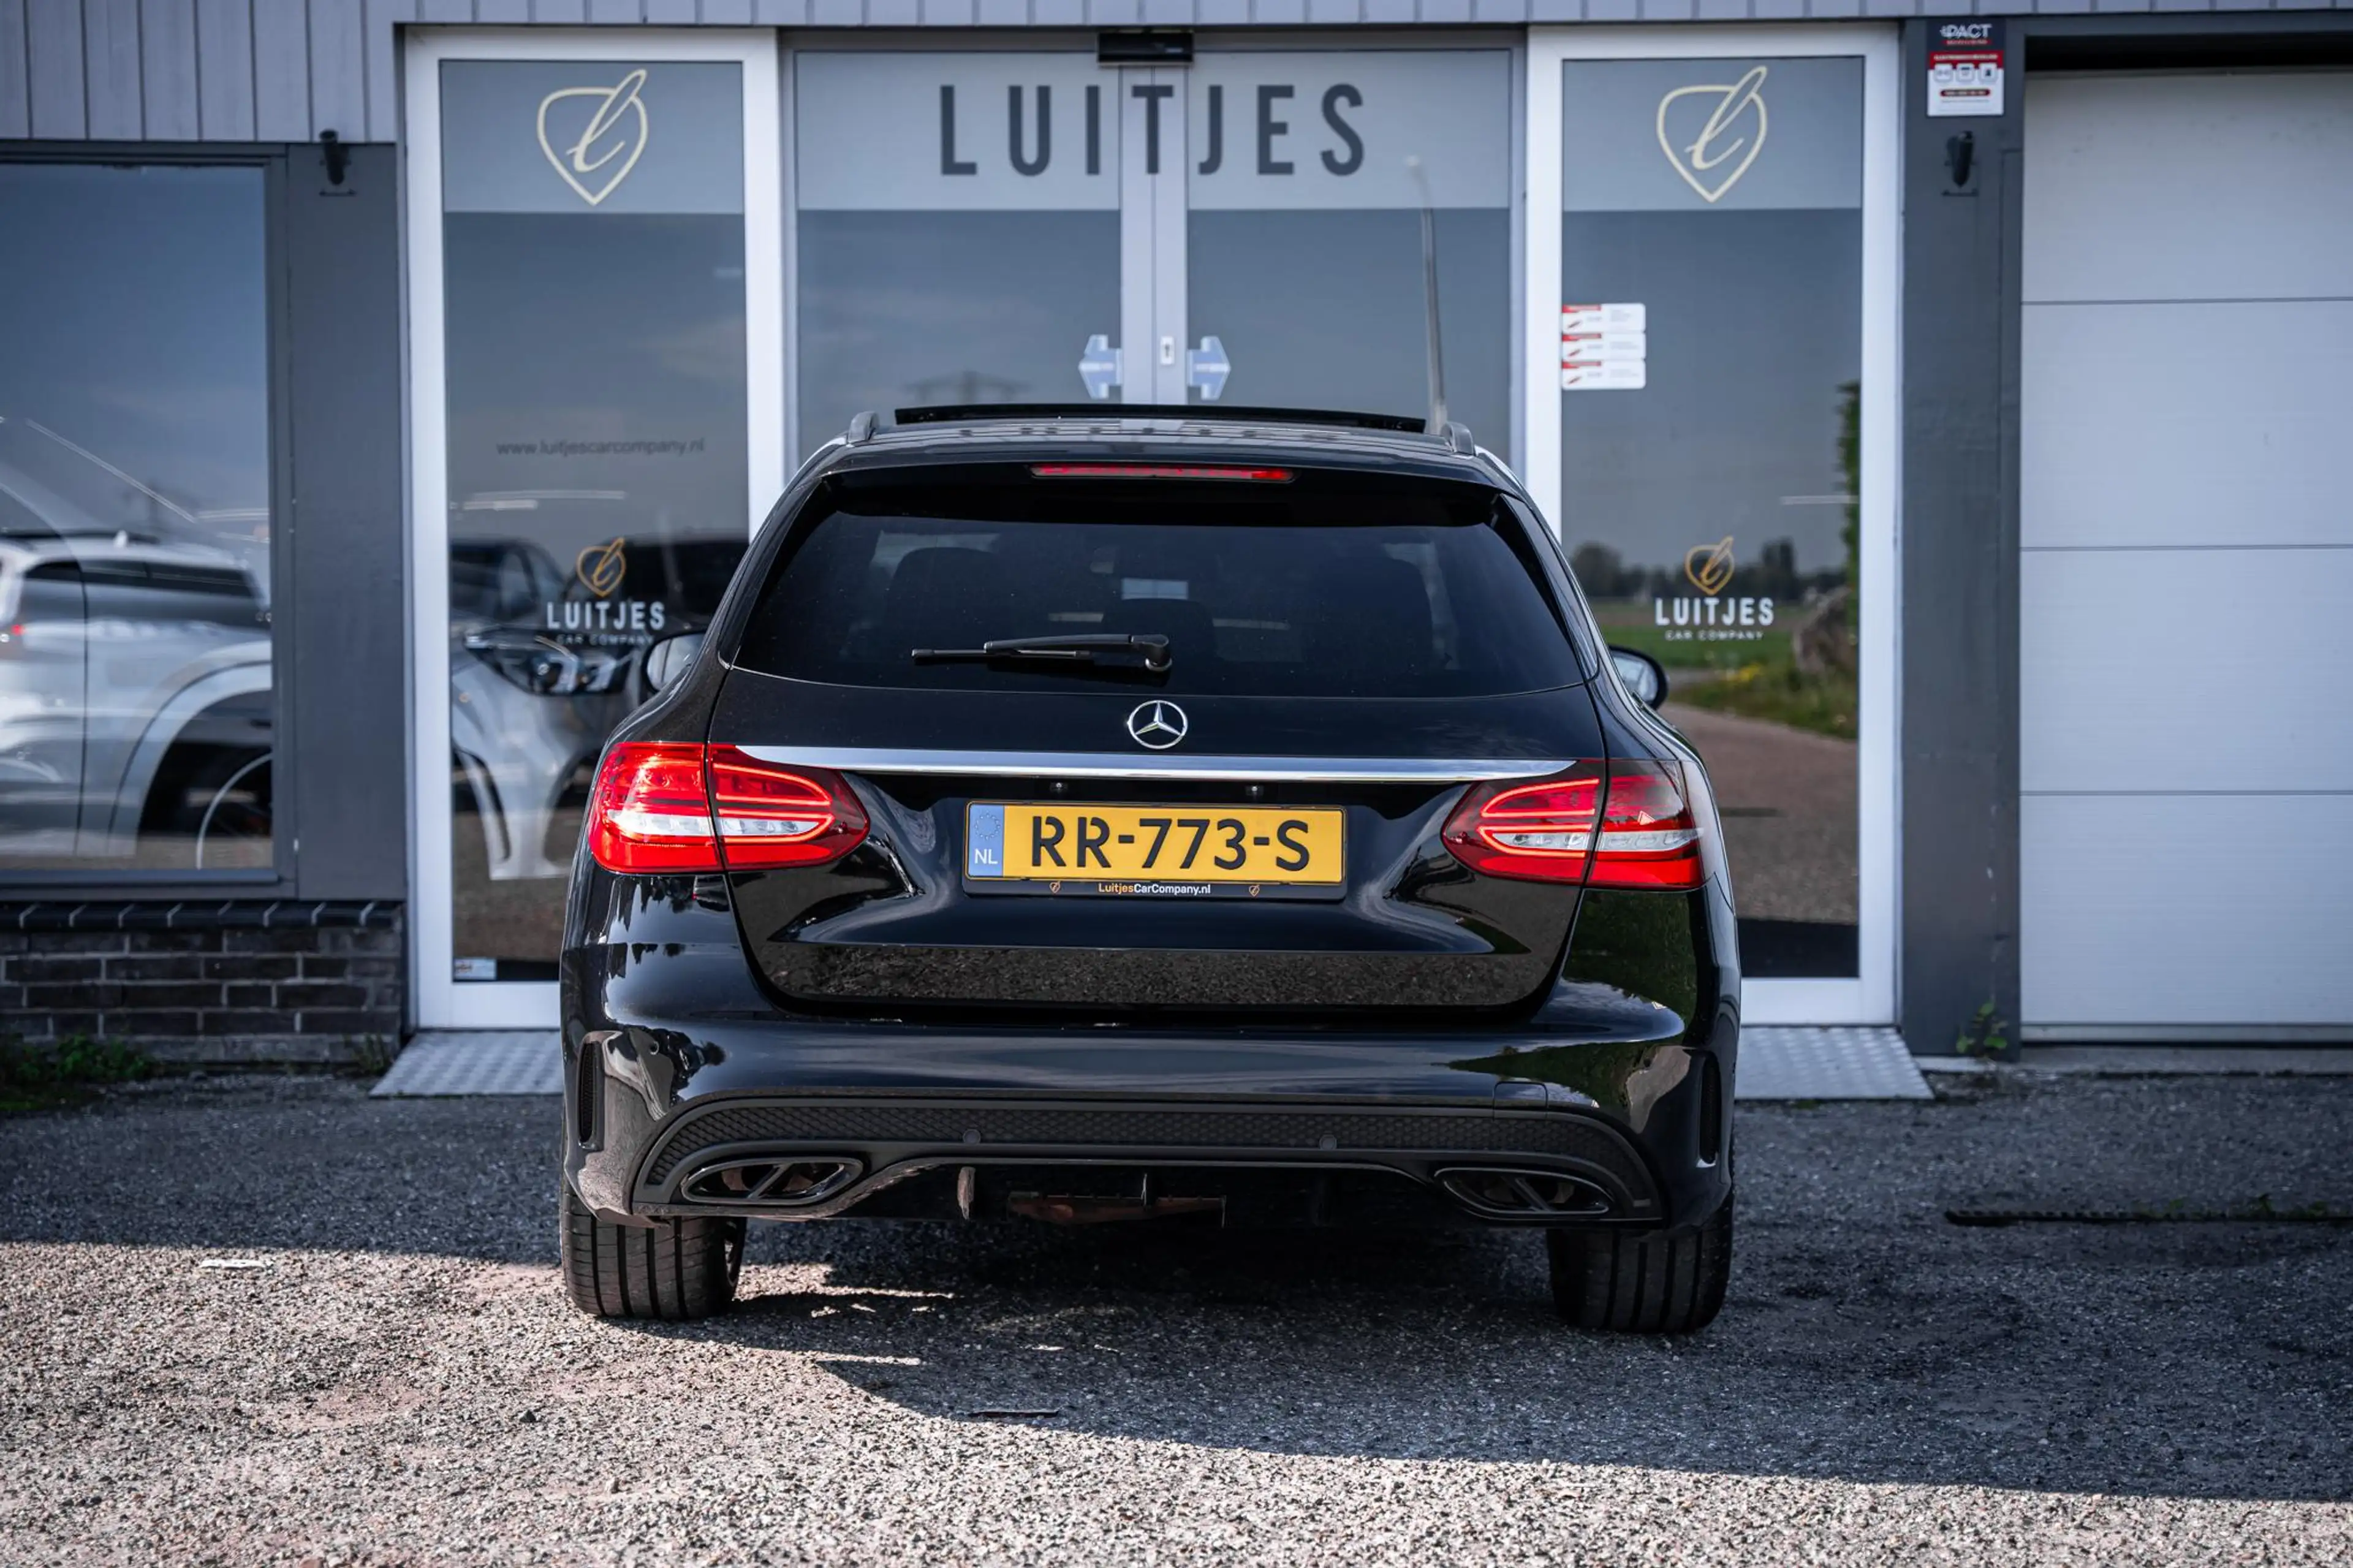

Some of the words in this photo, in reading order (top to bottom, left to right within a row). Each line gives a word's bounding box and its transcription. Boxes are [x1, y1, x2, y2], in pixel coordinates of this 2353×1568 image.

[940, 83, 1365, 177] LUITJES
[547, 600, 665, 631] LUITJES
[1655, 597, 1775, 626] LUITJES
[589, 634, 654, 645] COMPANY
[1664, 629, 1693, 641] CAR
[1697, 629, 1764, 641] COMPANY
[1031, 815, 1310, 871] RR-773-S
[974, 849, 998, 865] NL
[1098, 882, 1211, 896] LuitjesCarCompany.nl
